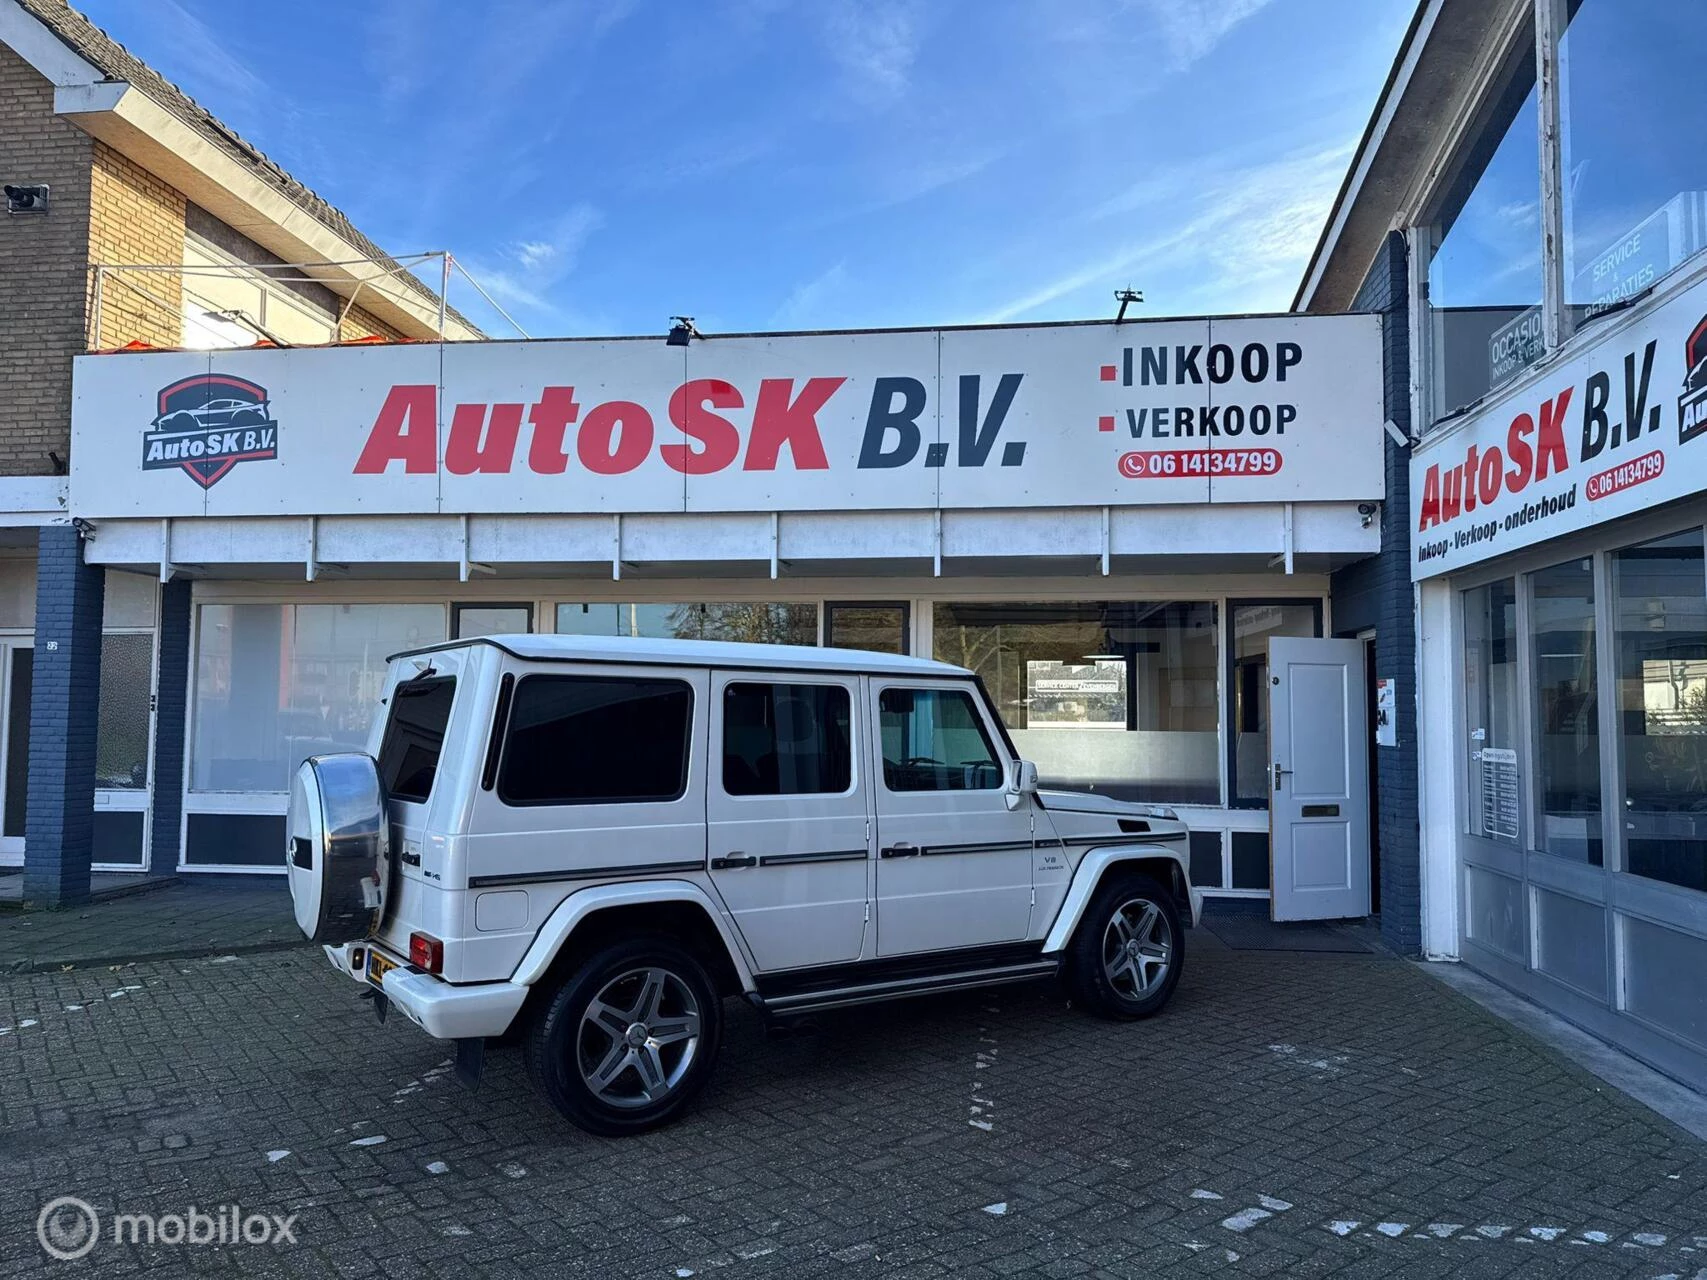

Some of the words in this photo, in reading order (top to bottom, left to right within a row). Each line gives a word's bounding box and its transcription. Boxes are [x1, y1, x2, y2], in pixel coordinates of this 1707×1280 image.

[1593, 234, 1641, 282] SERVICE
[1122, 342, 1303, 387] INKOOP
[1492, 354, 1517, 380] INKOOP
[352, 376, 848, 476] AutoSK
[857, 373, 1027, 470] B.V.
[1126, 404, 1297, 439] VERKOOP
[1418, 385, 1575, 533] AutoSK
[1580, 339, 1662, 463] B.V.
[146, 431, 242, 462] AutoSK
[243, 428, 275, 451] B.V.
[1149, 454, 1176, 474] 06
[1180, 451, 1277, 474] 14134799
[1600, 473, 1612, 494] 06
[1613, 453, 1662, 490] 14134799
[1418, 540, 1448, 563] Inkoop
[1454, 520, 1497, 551] Verkoop
[1504, 483, 1577, 532] onderhoud
